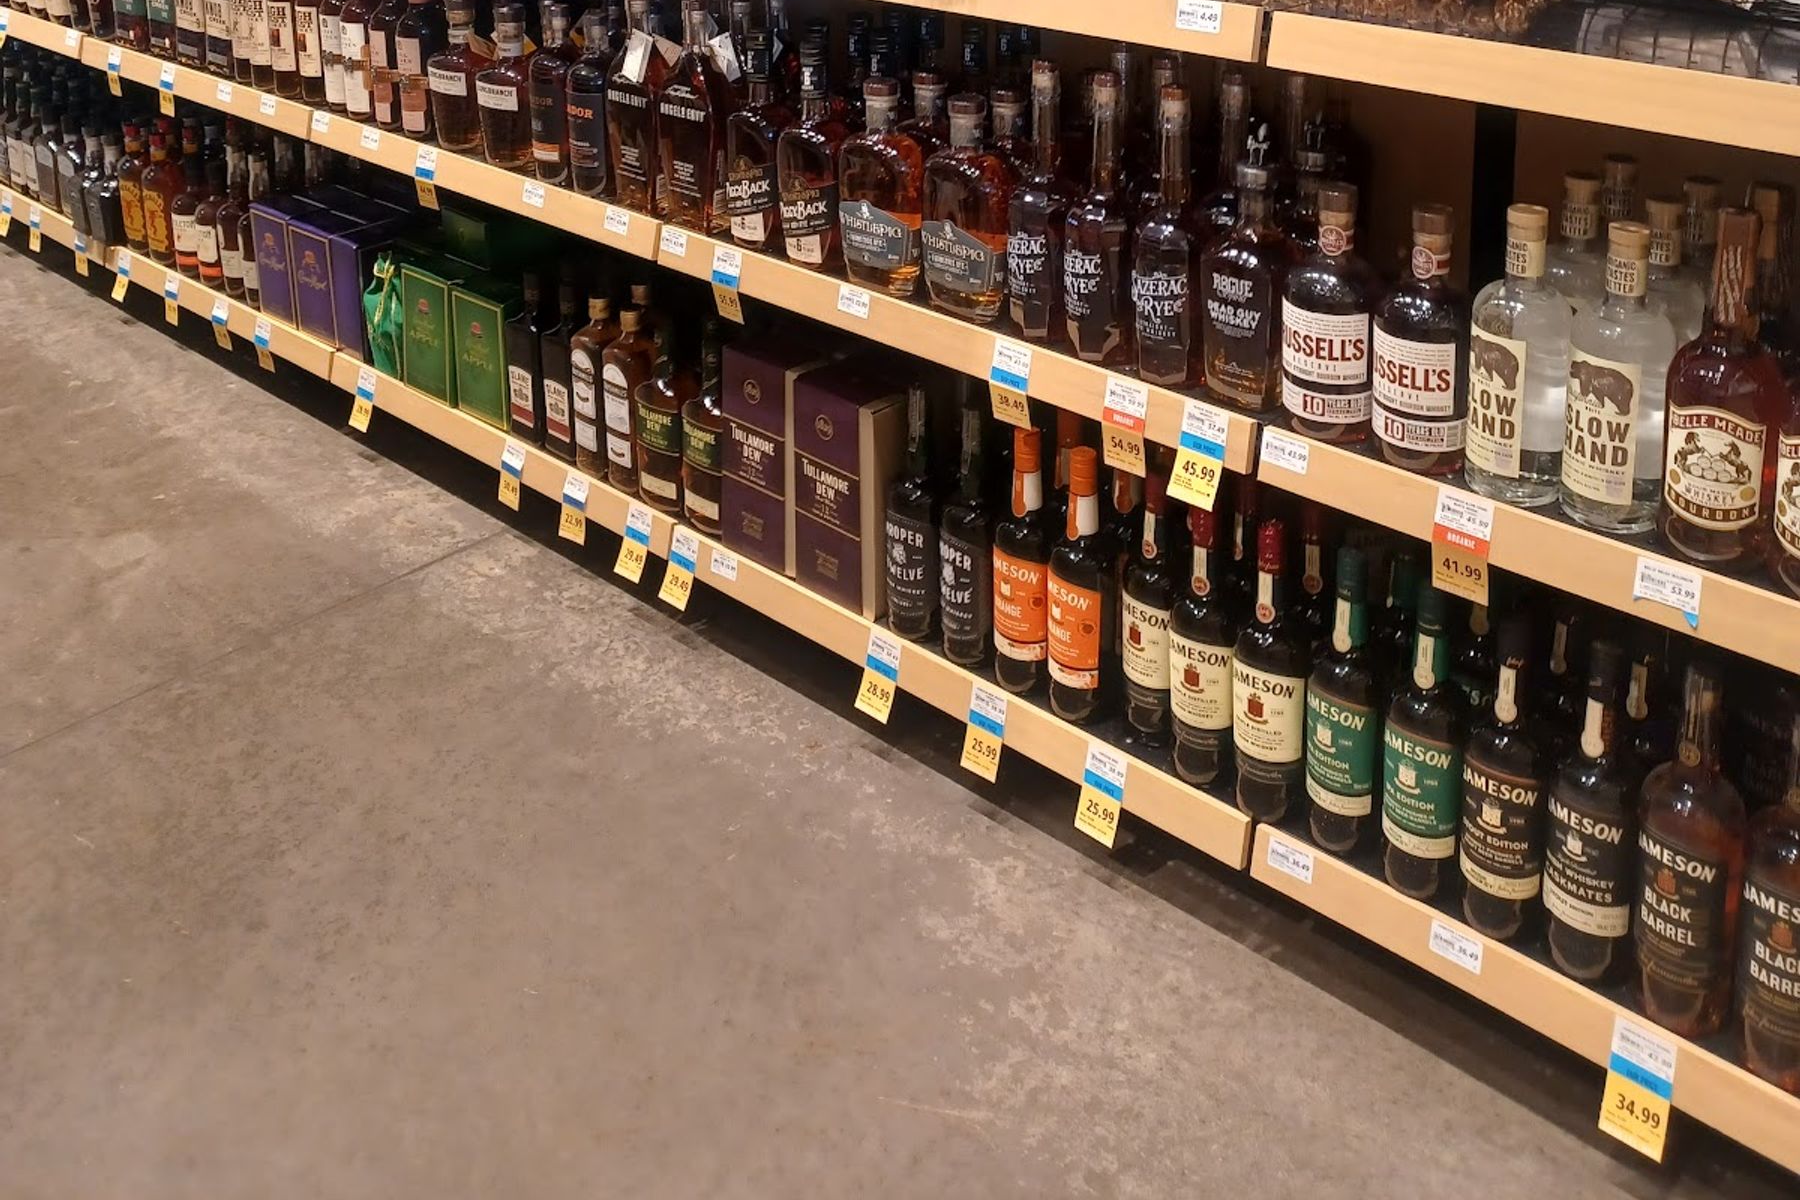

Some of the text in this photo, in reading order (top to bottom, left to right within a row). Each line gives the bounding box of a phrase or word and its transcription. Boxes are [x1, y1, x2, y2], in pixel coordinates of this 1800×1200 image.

[567, 104, 594, 120] ADOR
[1008, 237, 1046, 255] ZERAC
[1506, 252, 1528, 264] ASTES
[1507, 241, 1529, 253] GANIC
[1064, 257, 1102, 275] ZERAC
[1303, 394, 1325, 416] 10
[1469, 386, 1517, 417] LOW
[730, 422, 775, 456] TULLAMORE
[1385, 417, 1404, 441] 10
[1471, 412, 1515, 441] AND
[1566, 408, 1631, 445] SLOW
[1672, 414, 1762, 444] BELLE MEADE
[743, 444, 762, 462] DEW
[1110, 435, 1140, 457] 54.99
[1564, 433, 1629, 468] HAND
[801, 457, 850, 495] TULLAMORE
[1181, 459, 1216, 483] 45.99
[816, 481, 836, 500] DEW
[1668, 488, 1750, 520] BOURBON
[1684, 485, 1736, 505] WHISKEY
[940, 540, 972, 571] OPER
[1442, 556, 1482, 581] 41.99
[993, 558, 1040, 585] MESON
[1048, 581, 1090, 611] MESON
[1670, 585, 1696, 600] 53.99
[1123, 602, 1170, 632] MESON
[1170, 638, 1230, 668] AMESON
[866, 680, 891, 704] 28.99
[1233, 668, 1296, 699] AMESON
[1308, 690, 1366, 731] AMESON
[971, 737, 998, 761] 25.99
[1384, 728, 1452, 770] AMESON
[1085, 798, 1115, 825] 25.99
[1396, 792, 1436, 811] EDITION
[1486, 835, 1529, 851] EDITION
[1565, 866, 1614, 890] WHISKEY
[1644, 885, 1692, 924] BLACK
[1743, 880, 1800, 925] JAMES
[1640, 903, 1697, 947] BARREL
[1755, 939, 1800, 975] BLAC
[1750, 959, 1800, 999] BARRE
[1615, 1092, 1661, 1130] 34.99
